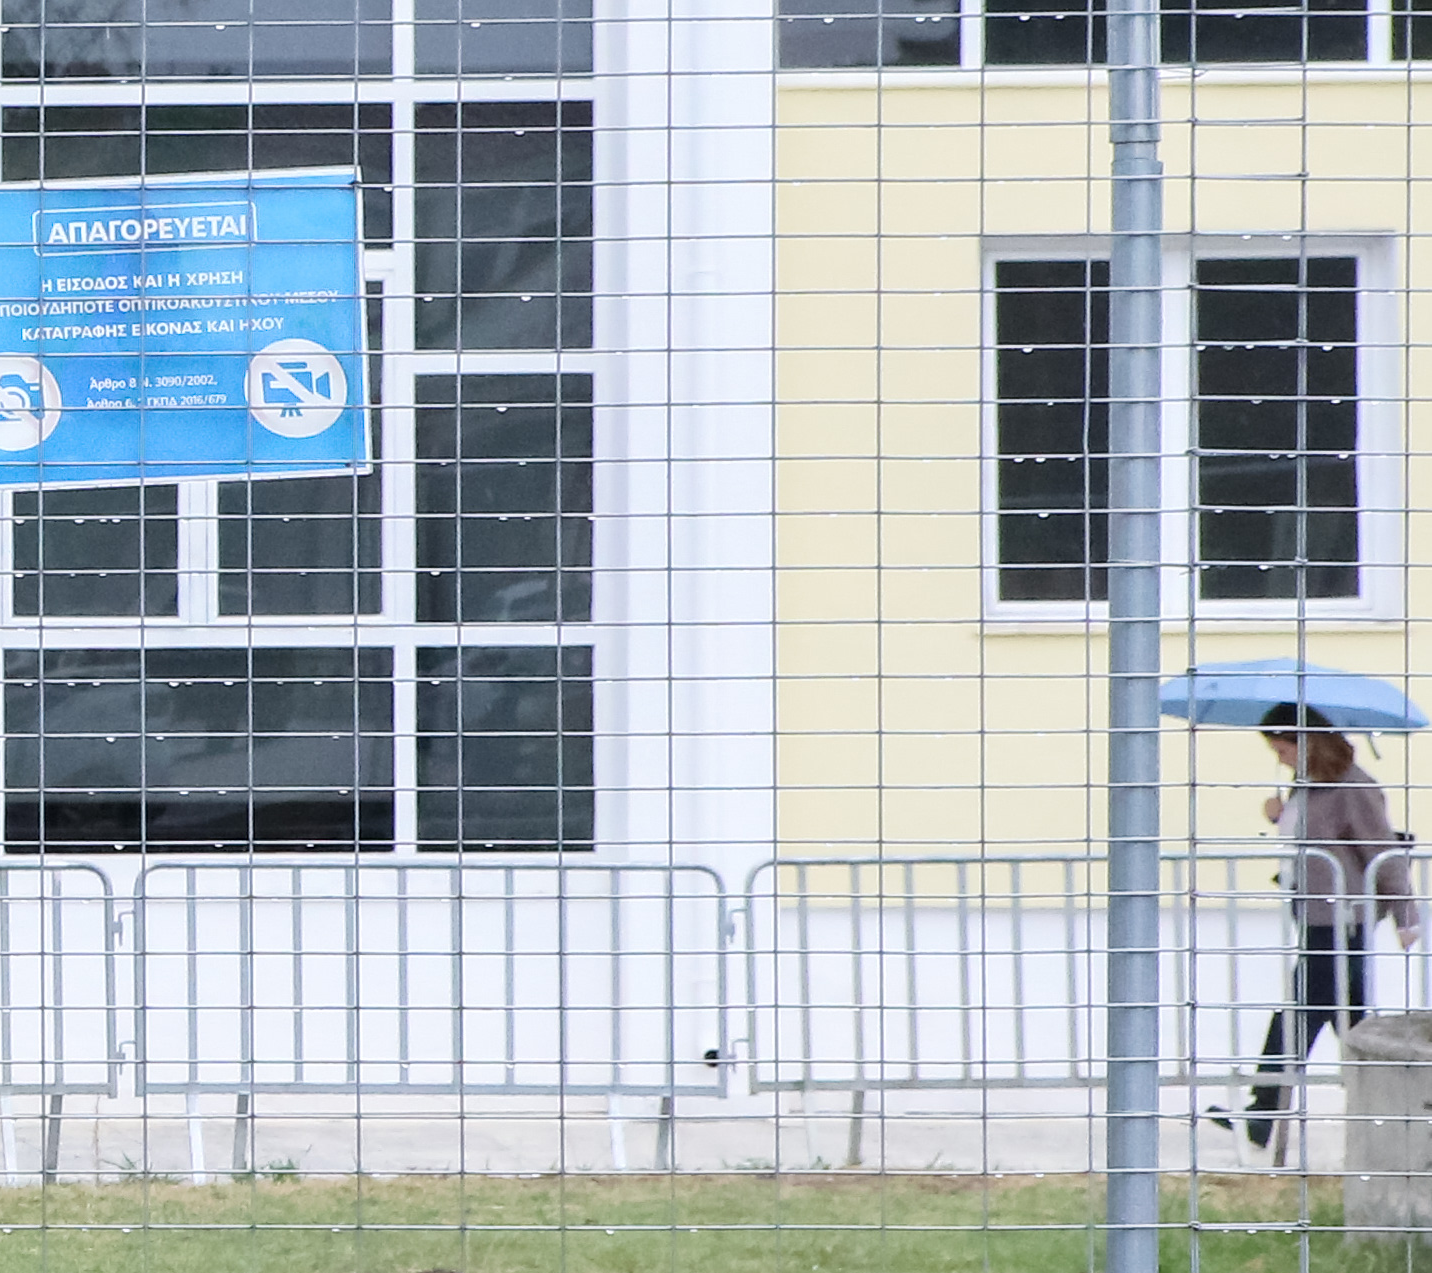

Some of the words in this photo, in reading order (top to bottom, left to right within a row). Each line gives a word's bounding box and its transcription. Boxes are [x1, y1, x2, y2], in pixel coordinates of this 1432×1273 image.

[47, 214, 247, 245] ΑΠΑΓΟΡΕΥΕΤΑΙ
[41, 279, 53, 293] Η
[56, 276, 128, 292] ΕΙΣΟΔΟΣ
[133, 274, 163, 289] ΚΑΙ
[168, 274, 181, 288] Η
[186, 270, 243, 286] ΧΡΗΣΗ
[21, 323, 127, 341] ΚΑΤΑΓΡΑΦΗΣ
[132, 320, 203, 337] ΕΚΟΝΑΣ
[207, 318, 235, 333] ΚΑΙ
[239, 316, 284, 332] ΗΧΟΥ
[89, 376, 127, 392] Άρθρο
[129, 377, 137, 389] 8
